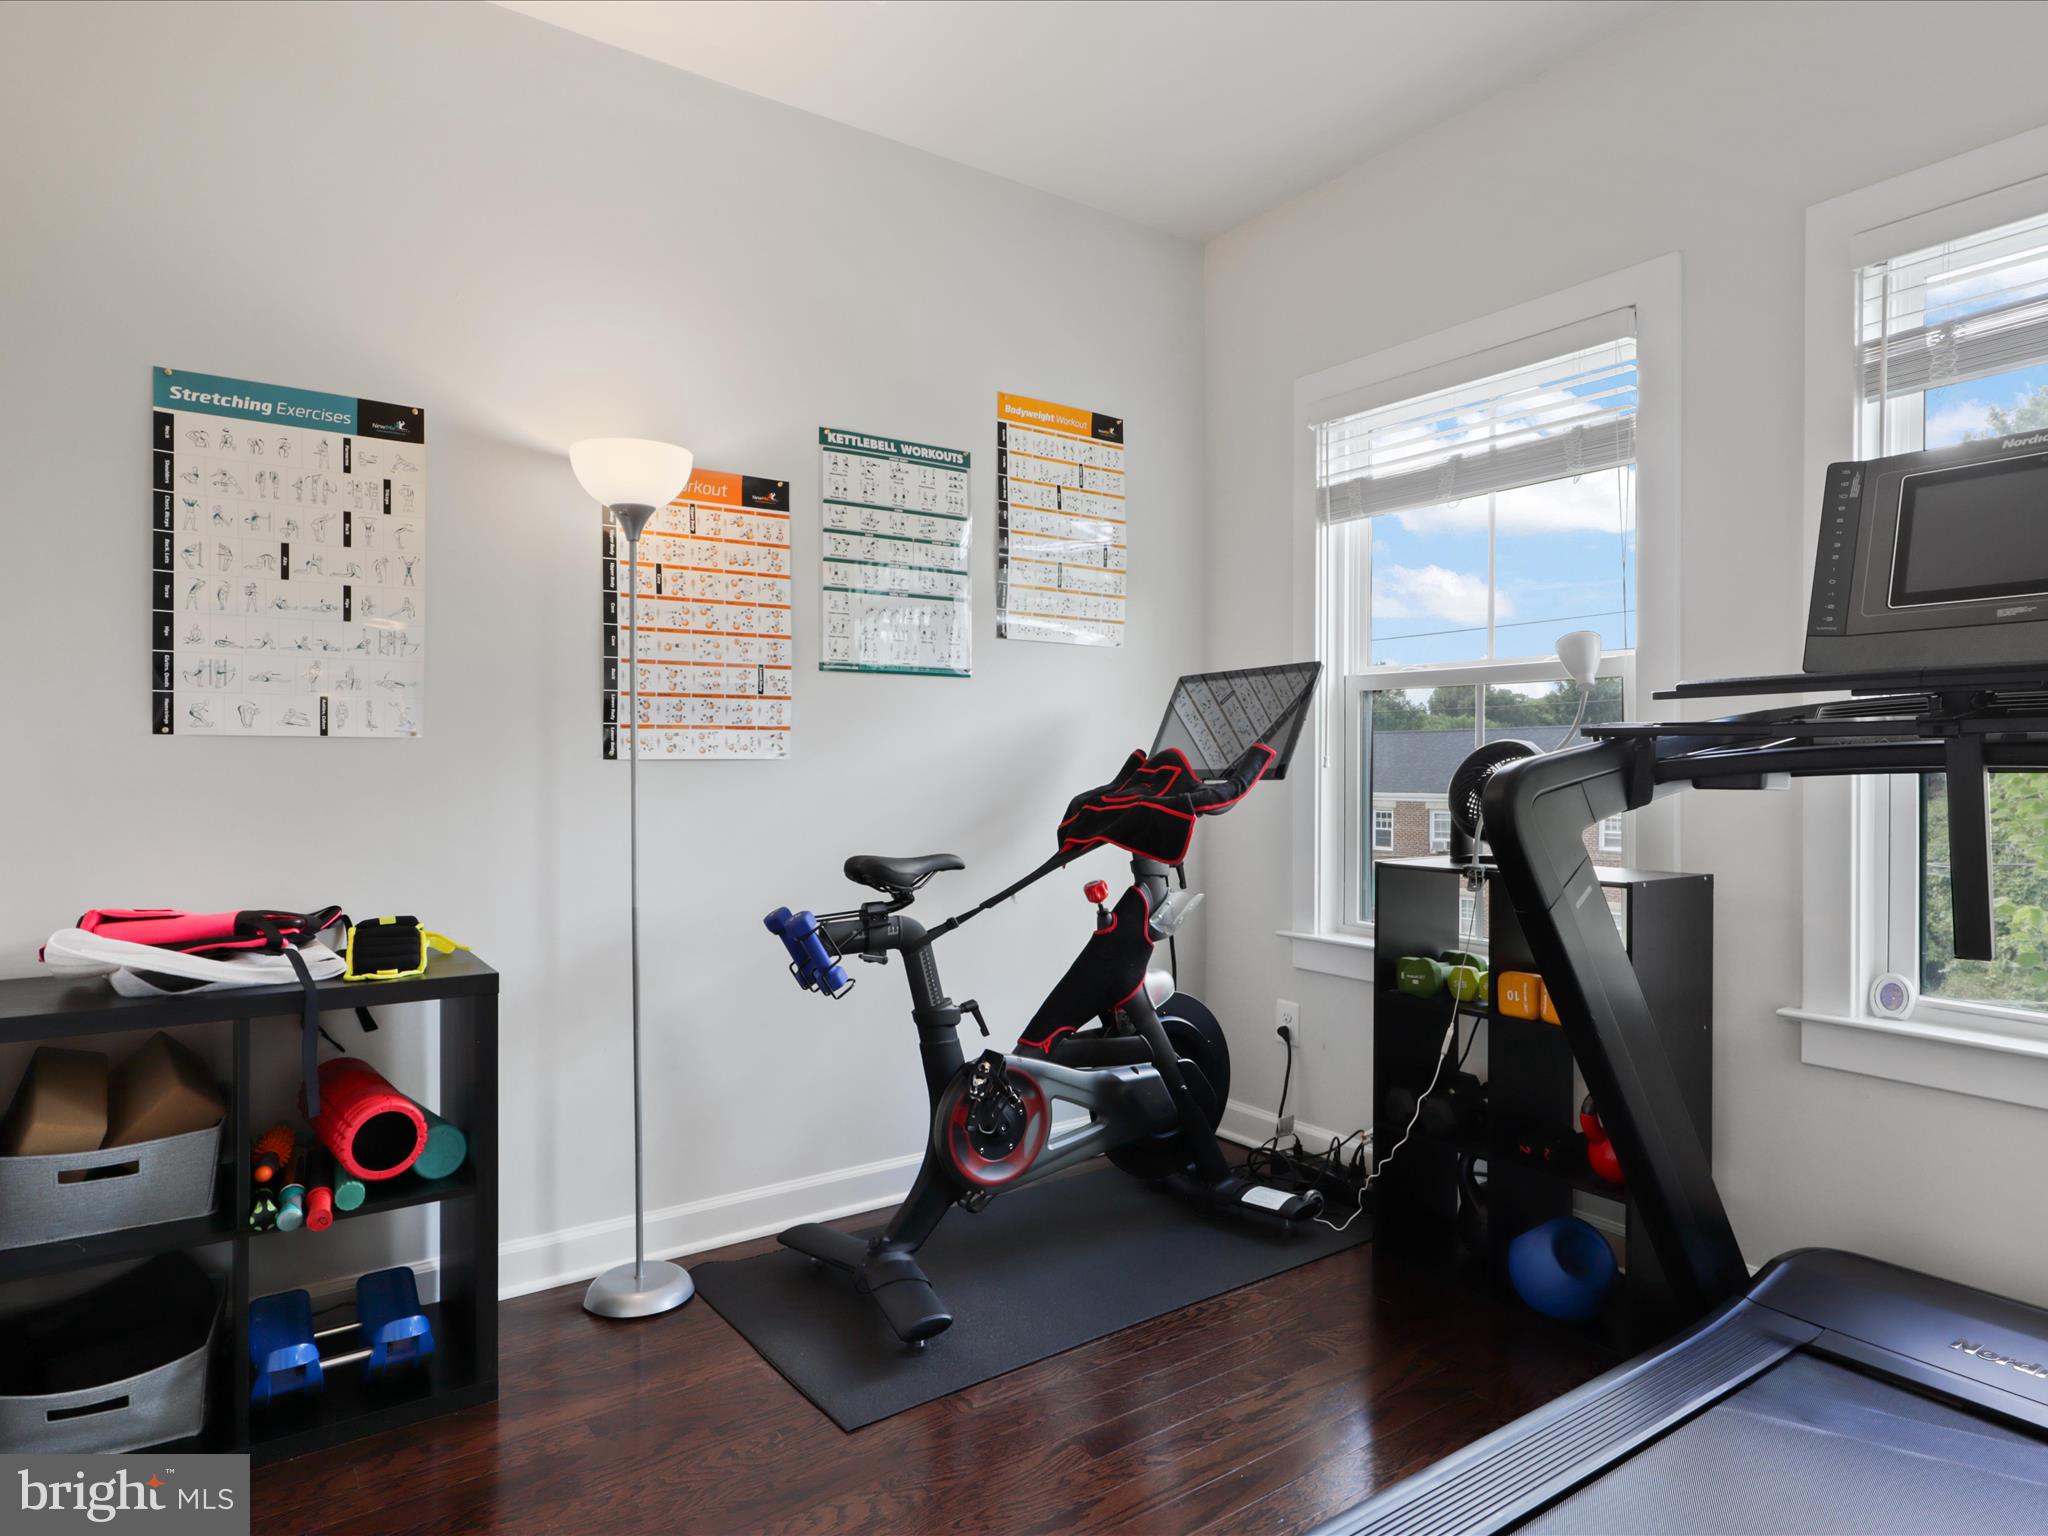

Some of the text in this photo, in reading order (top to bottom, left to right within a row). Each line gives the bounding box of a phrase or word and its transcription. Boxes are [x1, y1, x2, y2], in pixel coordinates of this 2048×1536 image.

[169, 385, 352, 424] Stretching Exercises
[1004, 404, 1088, 430] Bodyweight Workout
[828, 432, 964, 464] KETTLEBELL WORKOUTS
[1507, 990, 1520, 1002] 10
